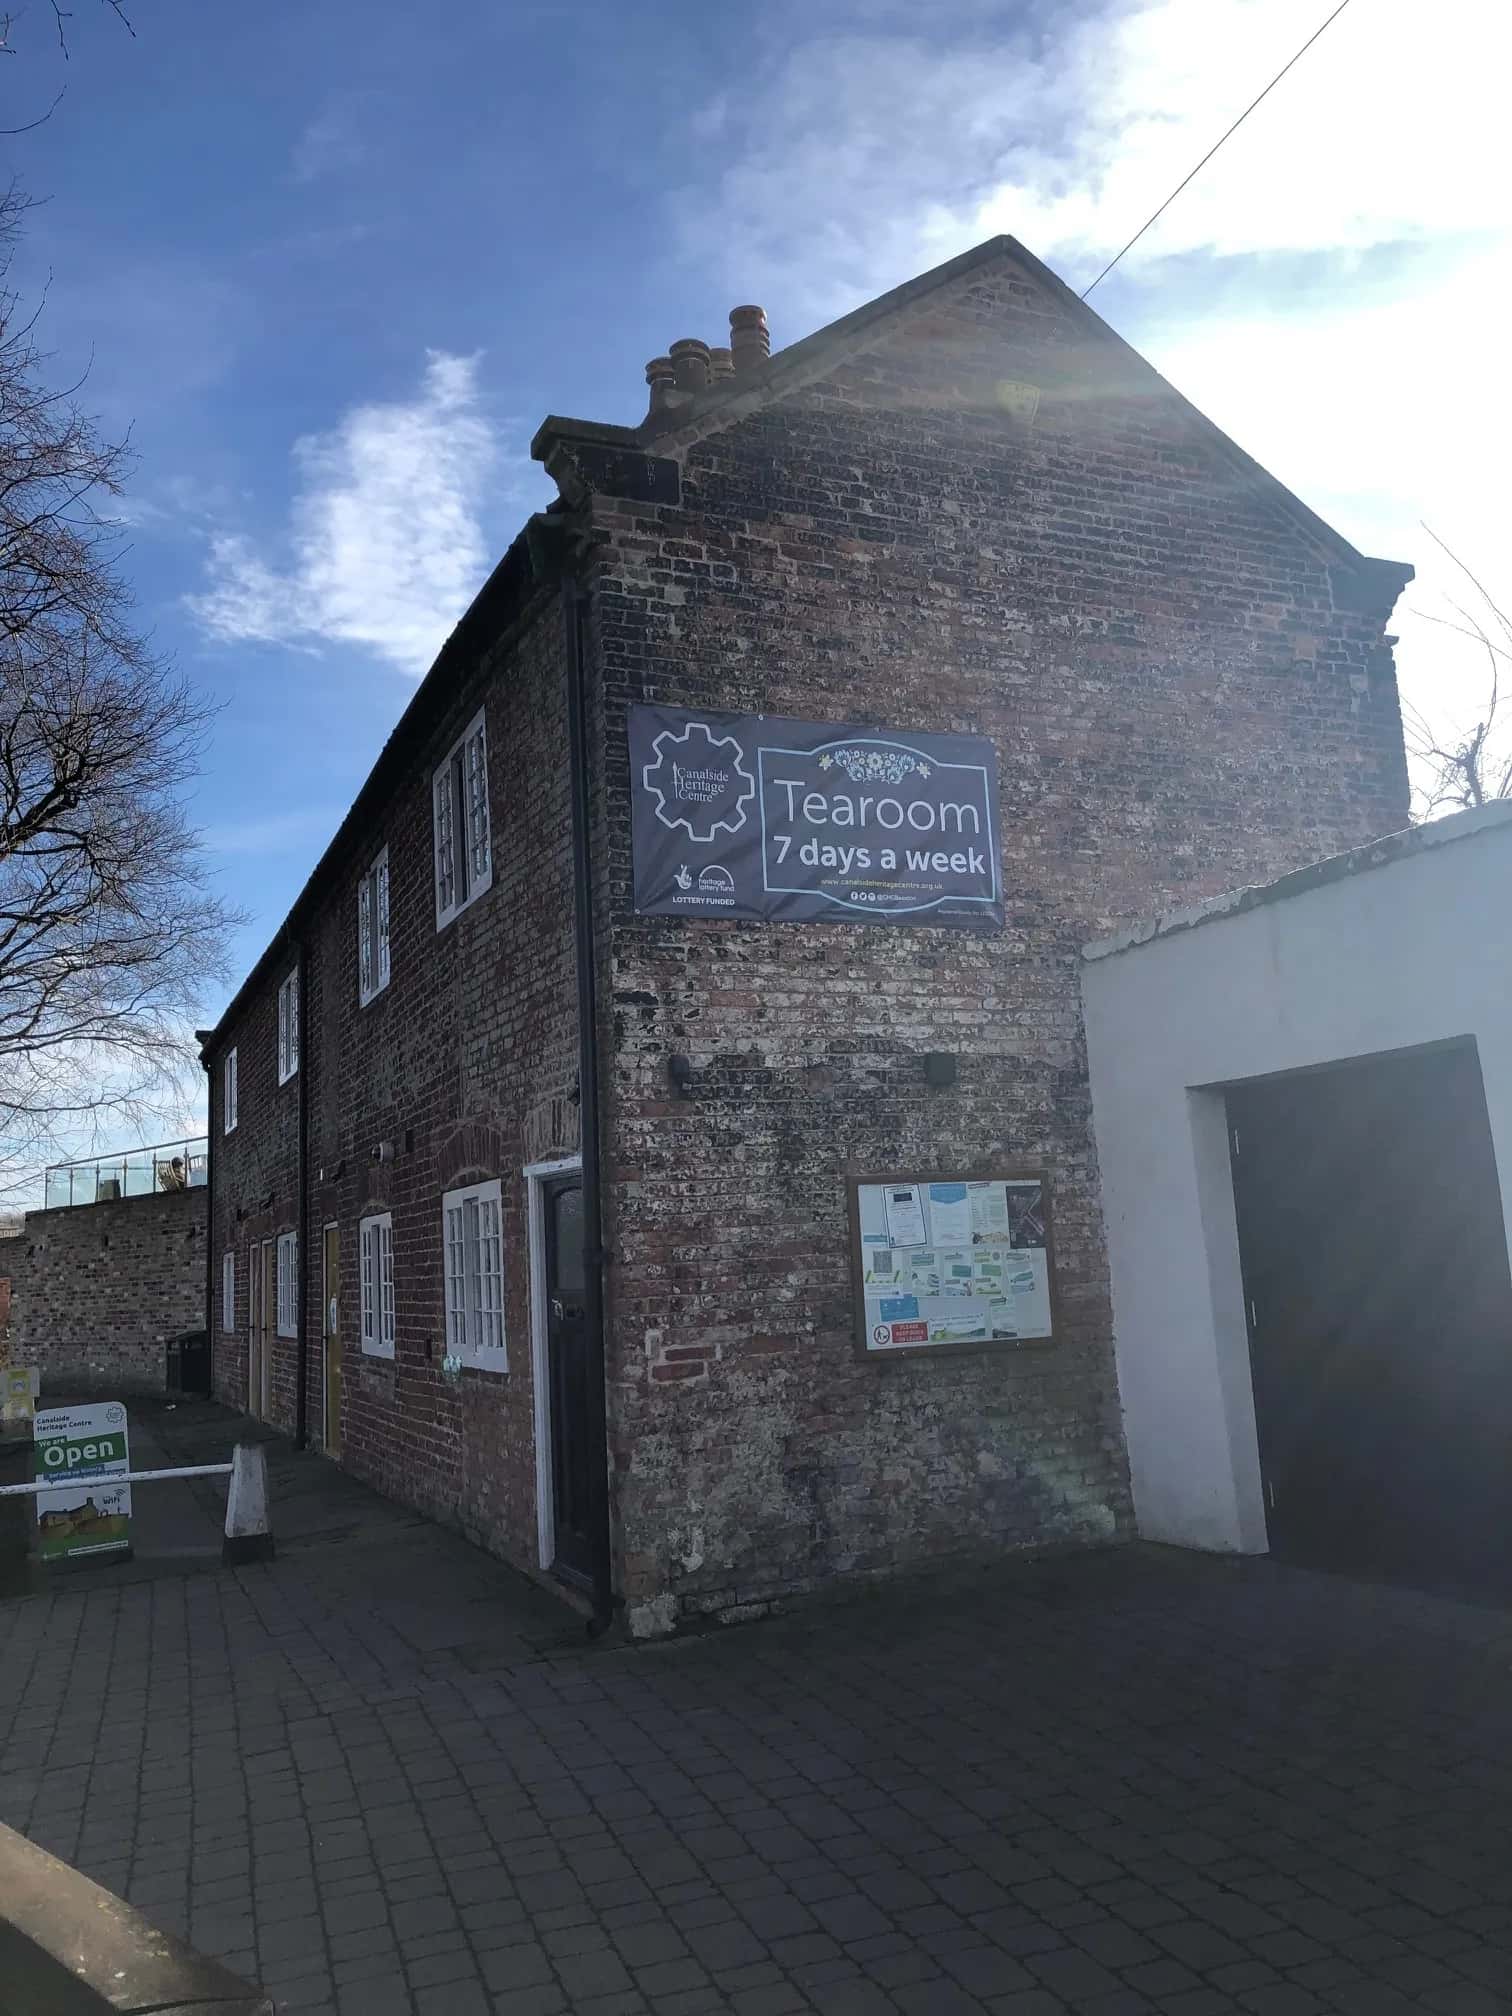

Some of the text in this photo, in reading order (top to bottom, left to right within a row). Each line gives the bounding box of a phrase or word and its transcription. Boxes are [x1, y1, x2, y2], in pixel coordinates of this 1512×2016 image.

[677, 767, 729, 782] Canalside
[672, 777, 725, 796] Heritage
[678, 789, 713, 802] Centre
[773, 779, 980, 834] Tearoom
[773, 835, 986, 875] 7 days a week
[672, 896, 735, 906] LOTTERY FUNDED
[36, 1415, 70, 1425] Canalside
[37, 1420, 92, 1433] Heritage Centre
[43, 1441, 114, 1468] Open
